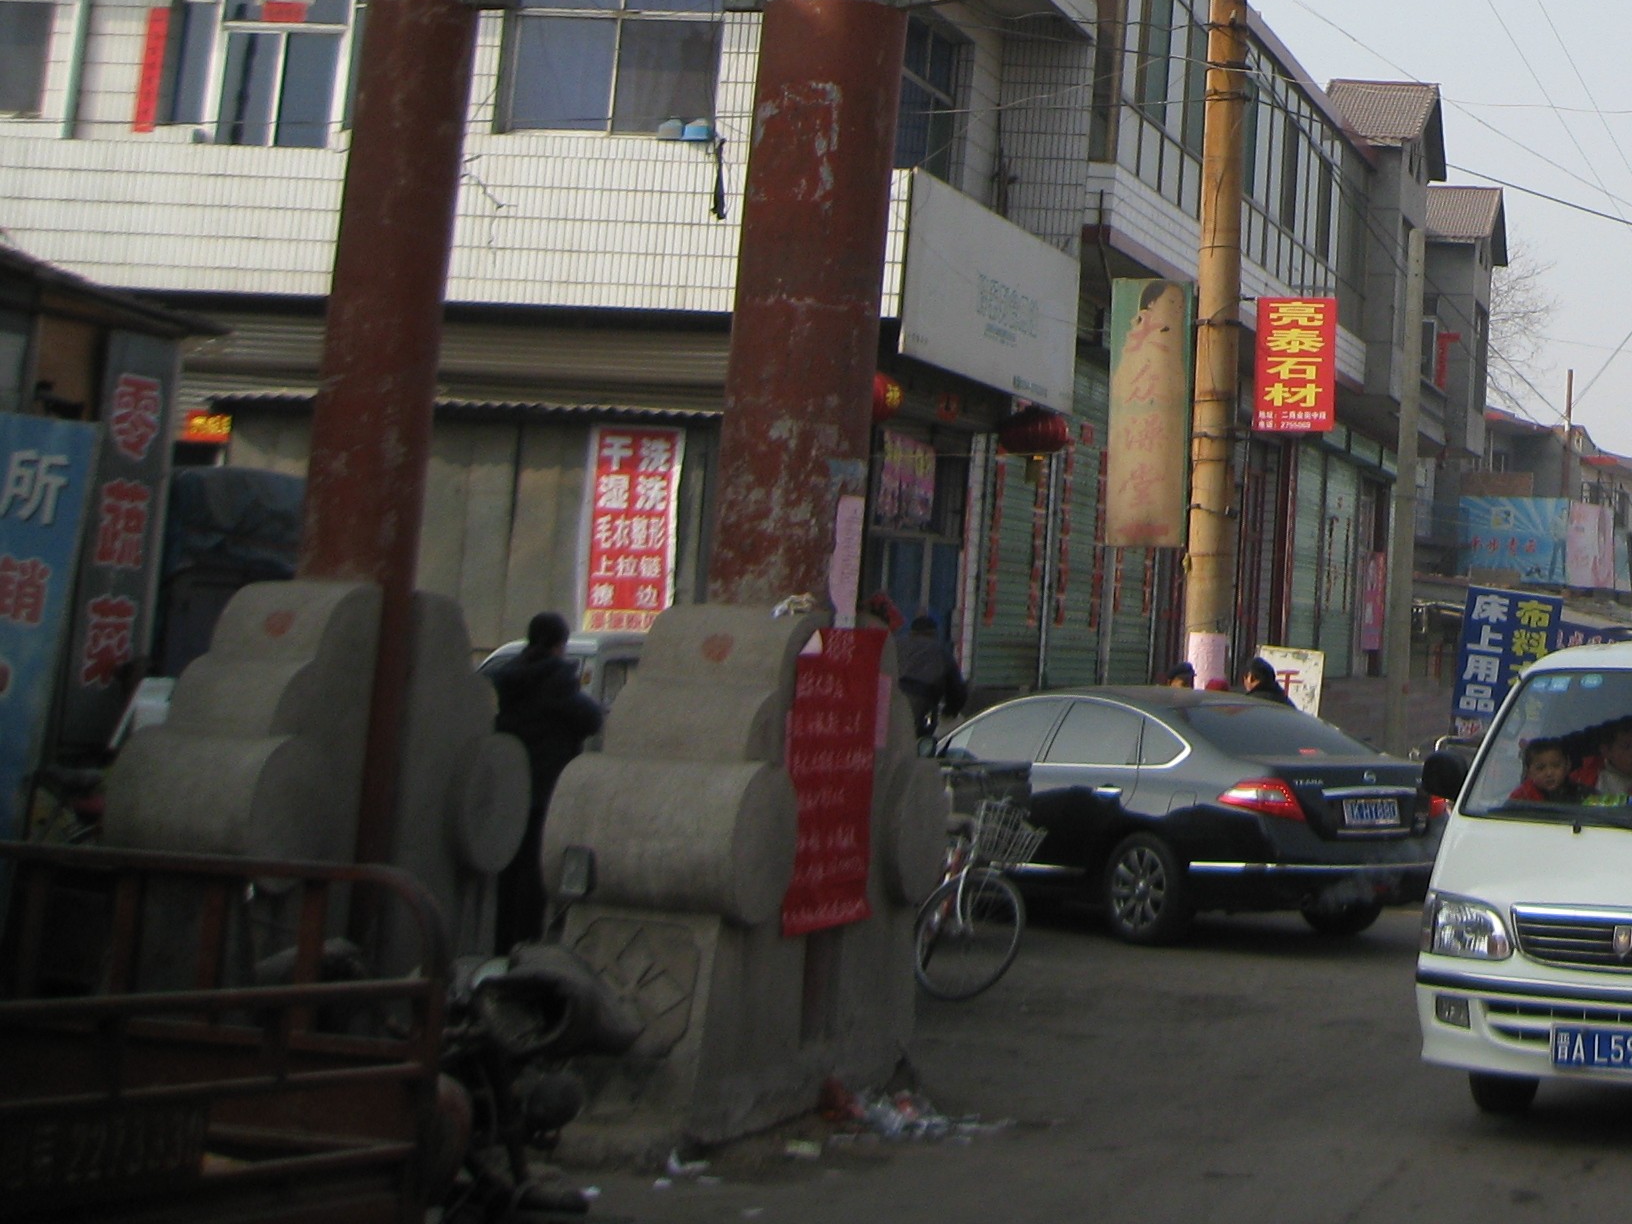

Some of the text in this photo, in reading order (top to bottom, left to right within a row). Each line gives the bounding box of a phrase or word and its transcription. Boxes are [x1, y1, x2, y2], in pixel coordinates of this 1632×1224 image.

[1262, 301, 1325, 408] 亮泰石材
[601, 435, 672, 473] 干洗
[0, 449, 70, 525] 所
[597, 473, 668, 511] 湿洗
[595, 514, 665, 550] 毛衣整形
[591, 553, 662, 578] 上拉链
[1459, 594, 1510, 713] 床上用品
